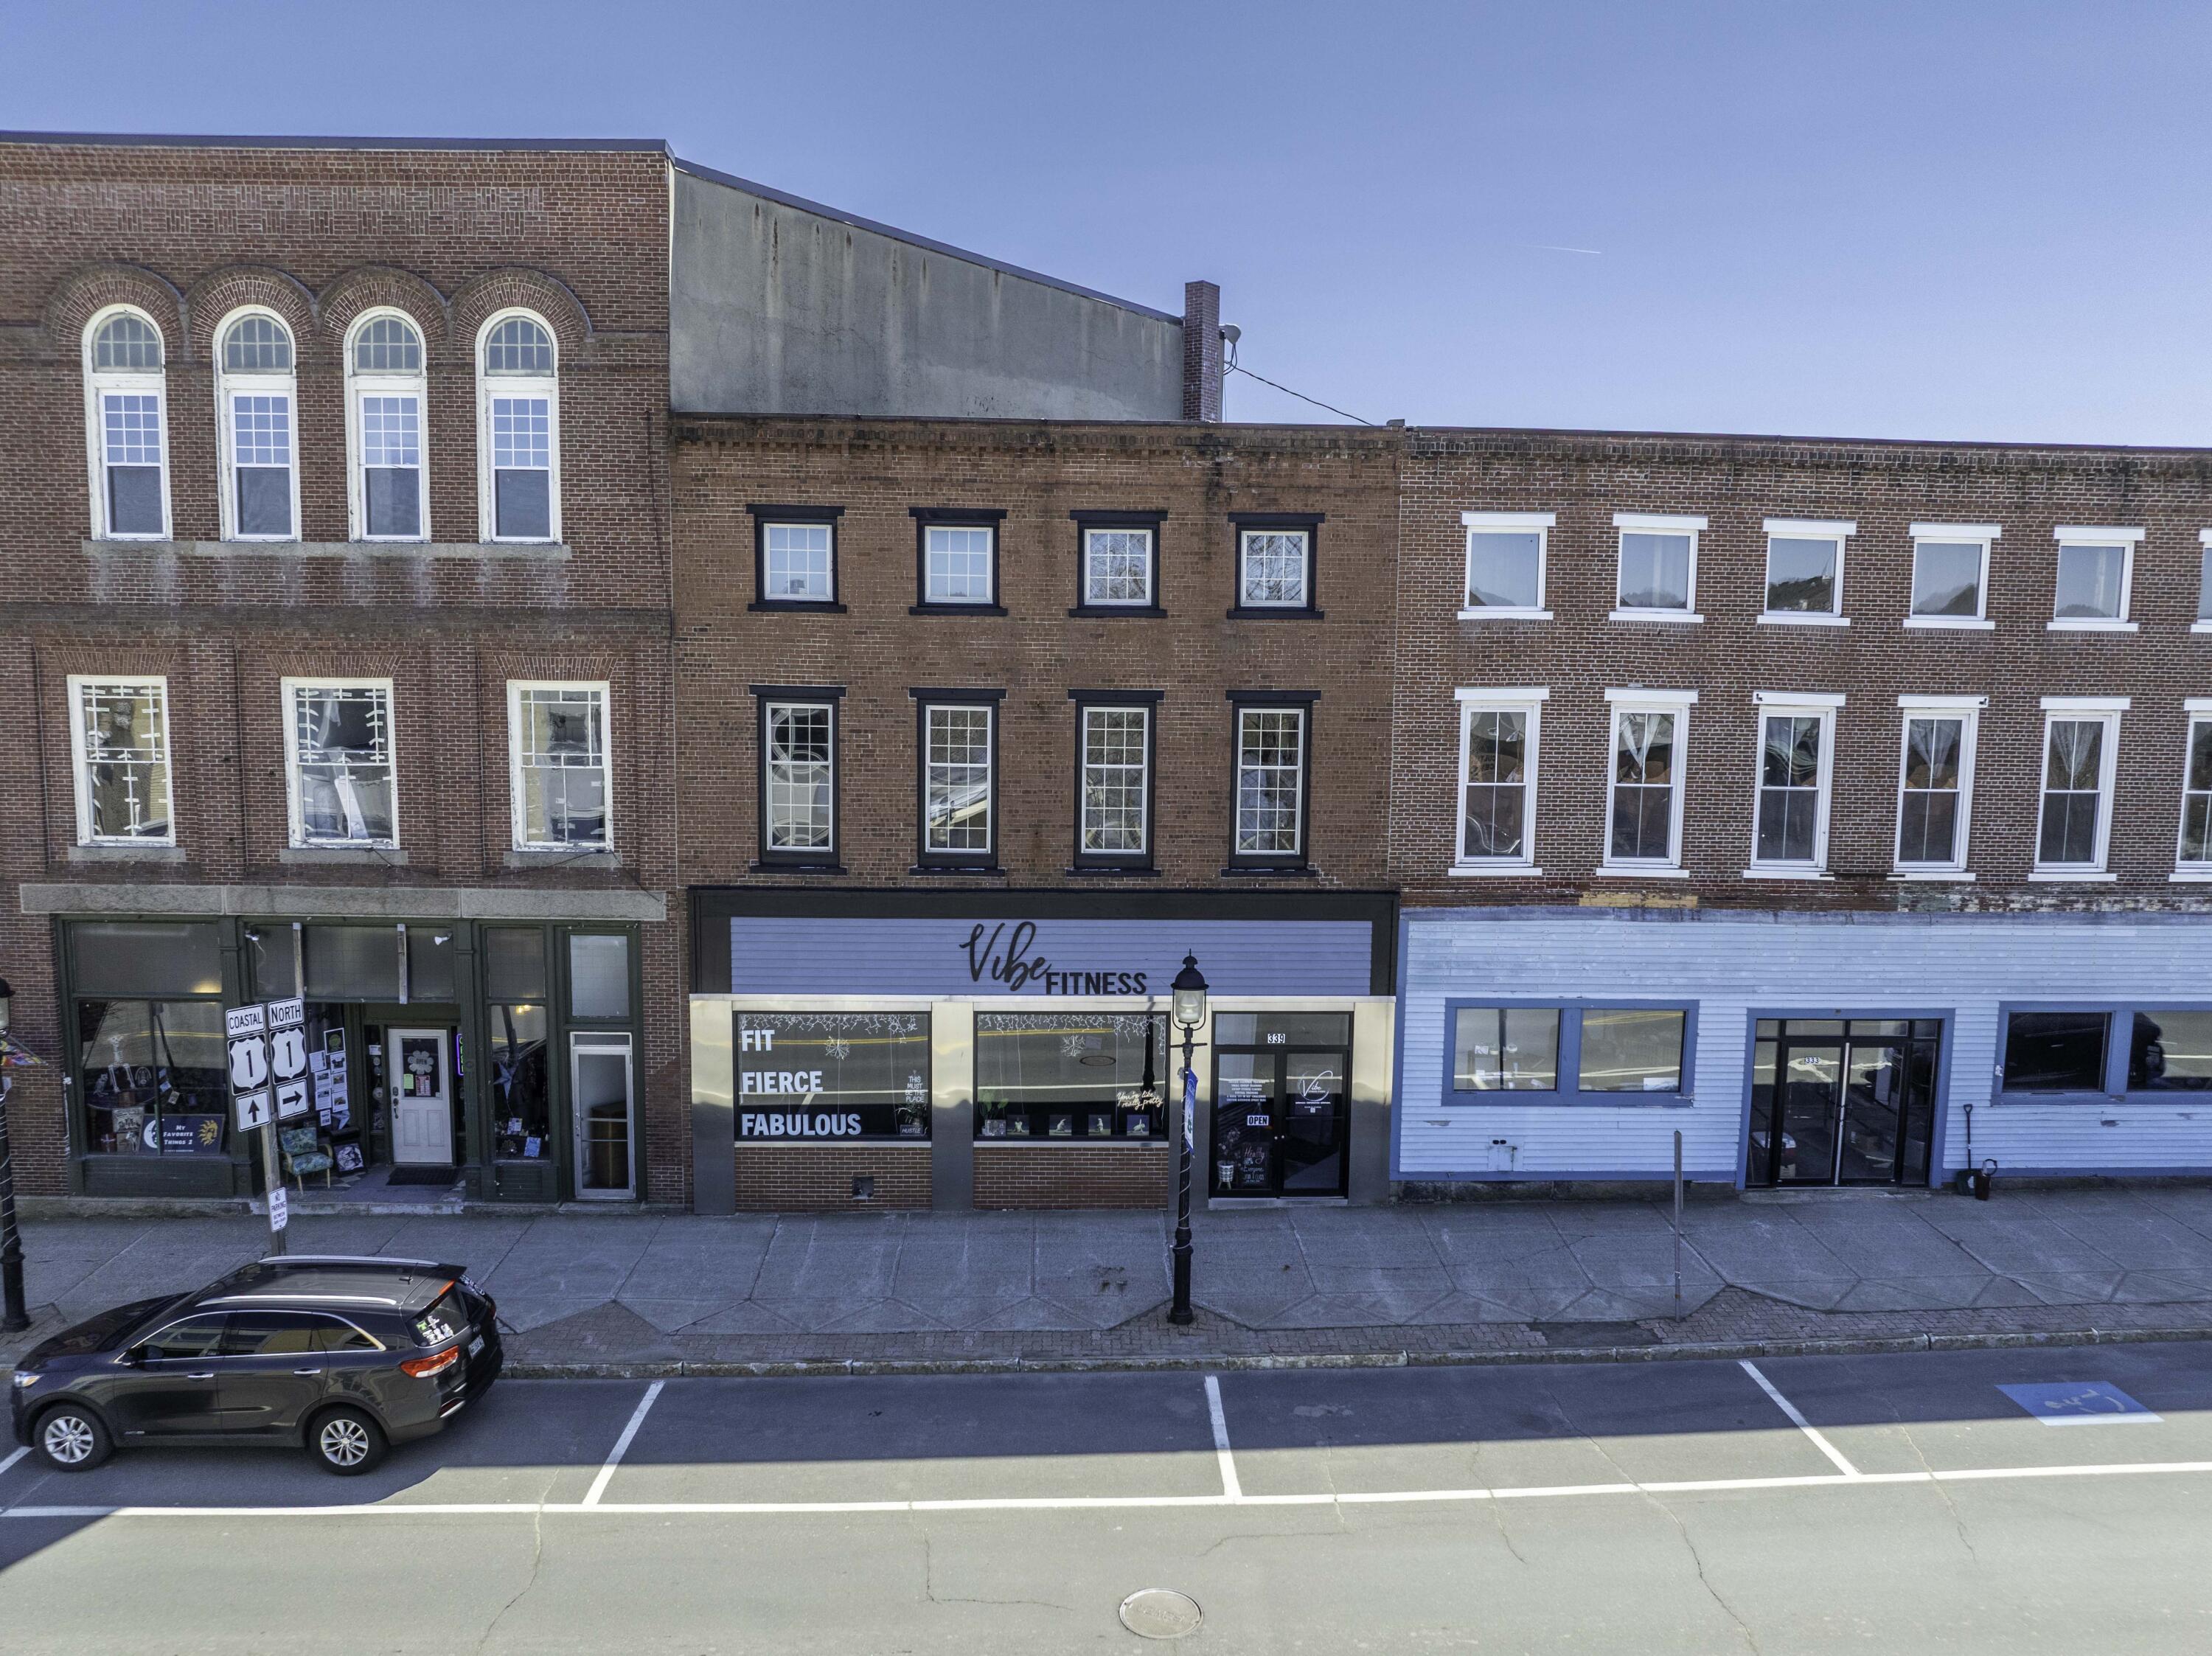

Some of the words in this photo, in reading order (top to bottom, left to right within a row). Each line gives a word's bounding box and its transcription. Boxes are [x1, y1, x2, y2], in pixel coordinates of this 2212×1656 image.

[959, 922, 1052, 992] Vibe
[1046, 972, 1147, 995] FITNESS
[229, 1012, 262, 1029] COASTAL
[271, 1004, 302, 1023] NORTH
[742, 1030, 775, 1051] FIT
[1268, 1034, 1284, 1043] 339
[246, 1050, 254, 1077] 1
[286, 1040, 293, 1068] 1
[742, 1071, 824, 1093] FIERCE
[1303, 1070, 1333, 1096] Vibe
[1141, 1096, 1164, 1110] pretty
[742, 1114, 862, 1135] FABULOUS
[1249, 1116, 1267, 1124] OPEN
[271, 1200, 286, 1211] PARKING
